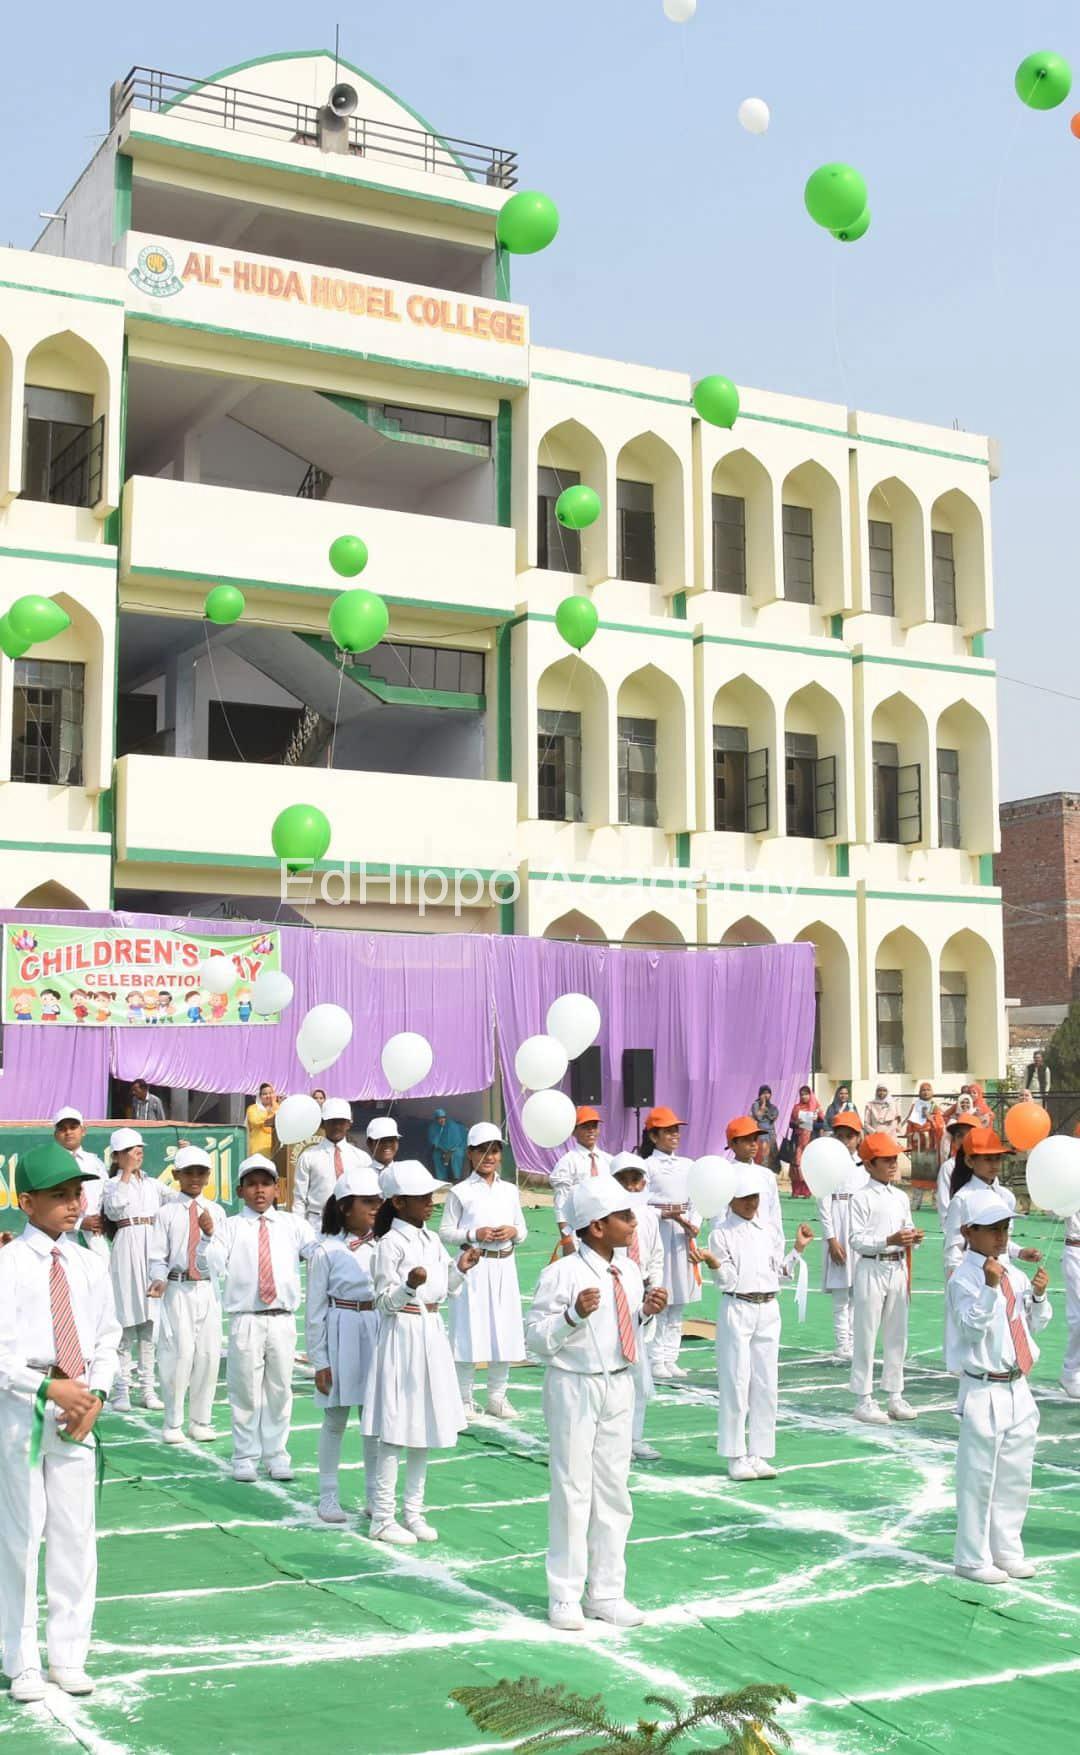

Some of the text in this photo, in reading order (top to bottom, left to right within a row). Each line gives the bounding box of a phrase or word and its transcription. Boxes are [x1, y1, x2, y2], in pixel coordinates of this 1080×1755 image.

[181, 251, 305, 304] AL-HUDA
[406, 294, 525, 346] COLLEGE
[20, 938, 262, 983] CHILDREN'S AY
[84, 973, 201, 988] CELEBRATIO
